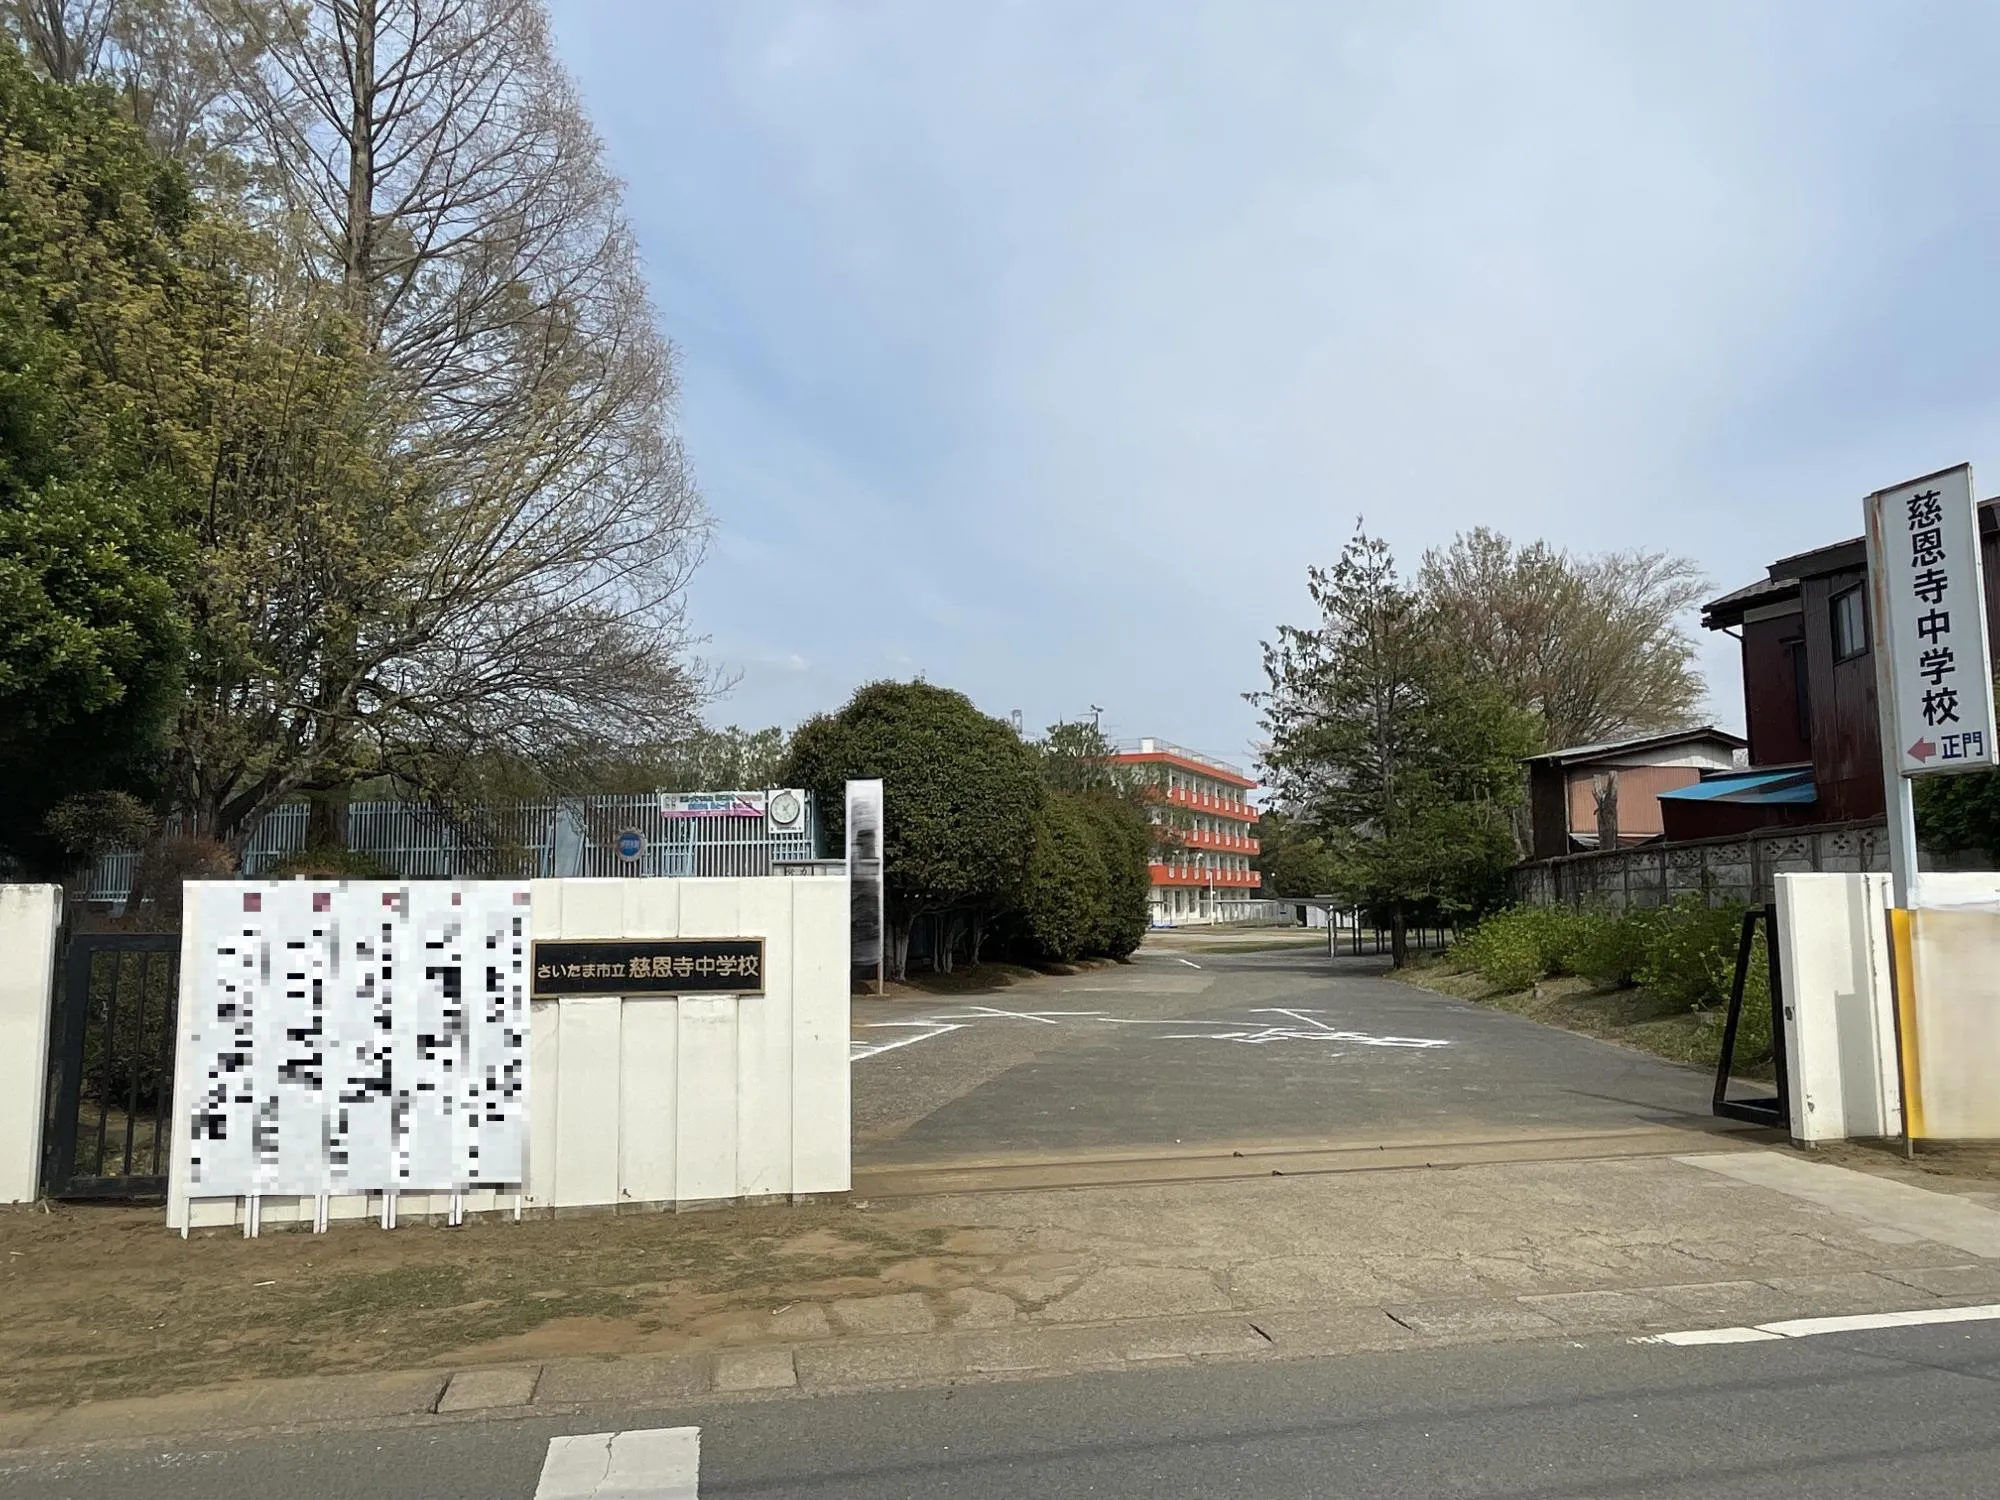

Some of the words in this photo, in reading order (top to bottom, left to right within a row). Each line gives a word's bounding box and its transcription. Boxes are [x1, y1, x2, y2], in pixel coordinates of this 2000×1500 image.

[1906, 490, 1960, 726] 慈恩寺中学校
[1941, 731, 1984, 759] 正門
[537, 964, 626, 979] さいたま市立
[630, 955, 759, 978] 慈恩寺中学校
